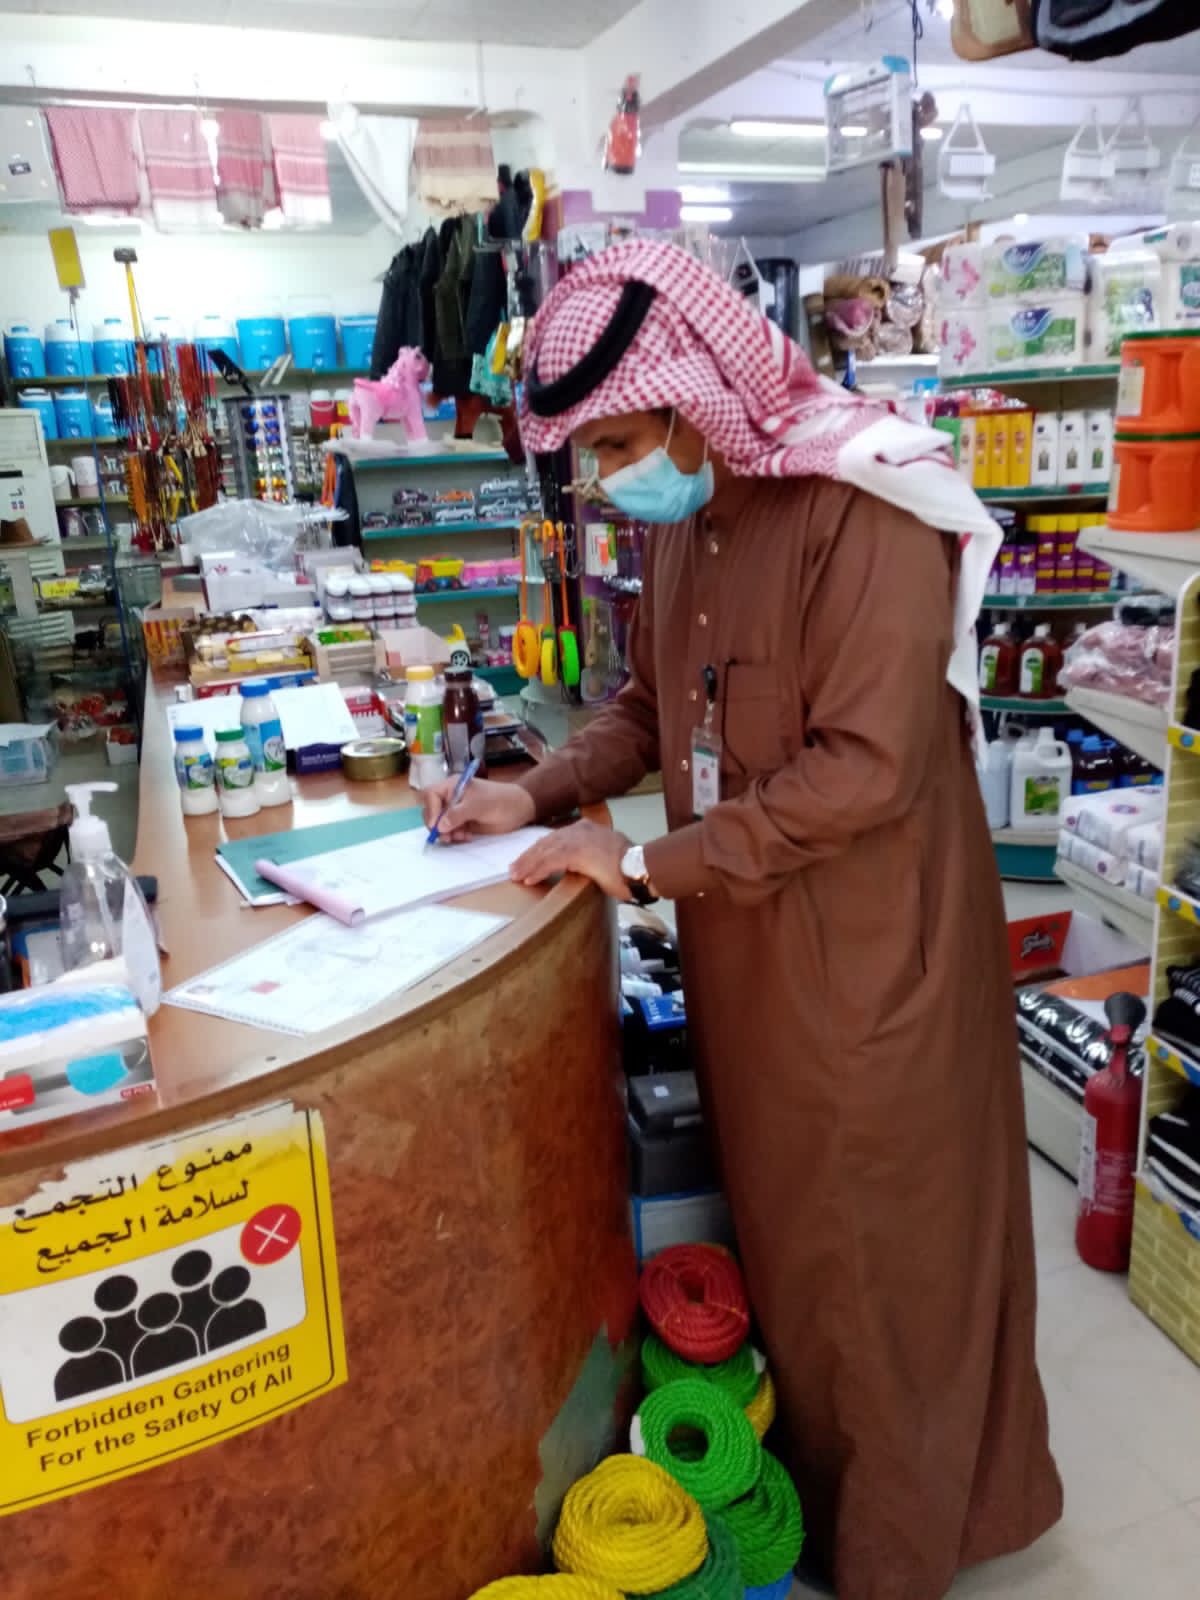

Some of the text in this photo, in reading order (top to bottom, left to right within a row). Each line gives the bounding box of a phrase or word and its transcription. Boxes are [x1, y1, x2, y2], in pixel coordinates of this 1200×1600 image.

[156, 1141, 253, 1192] ممنوع
[36, 1180, 249, 1273] لسلامة الجميع
[26, 1343, 291, 1448] Forbidden Gathering
[39, 1365, 293, 1472] For the Safety Of All
